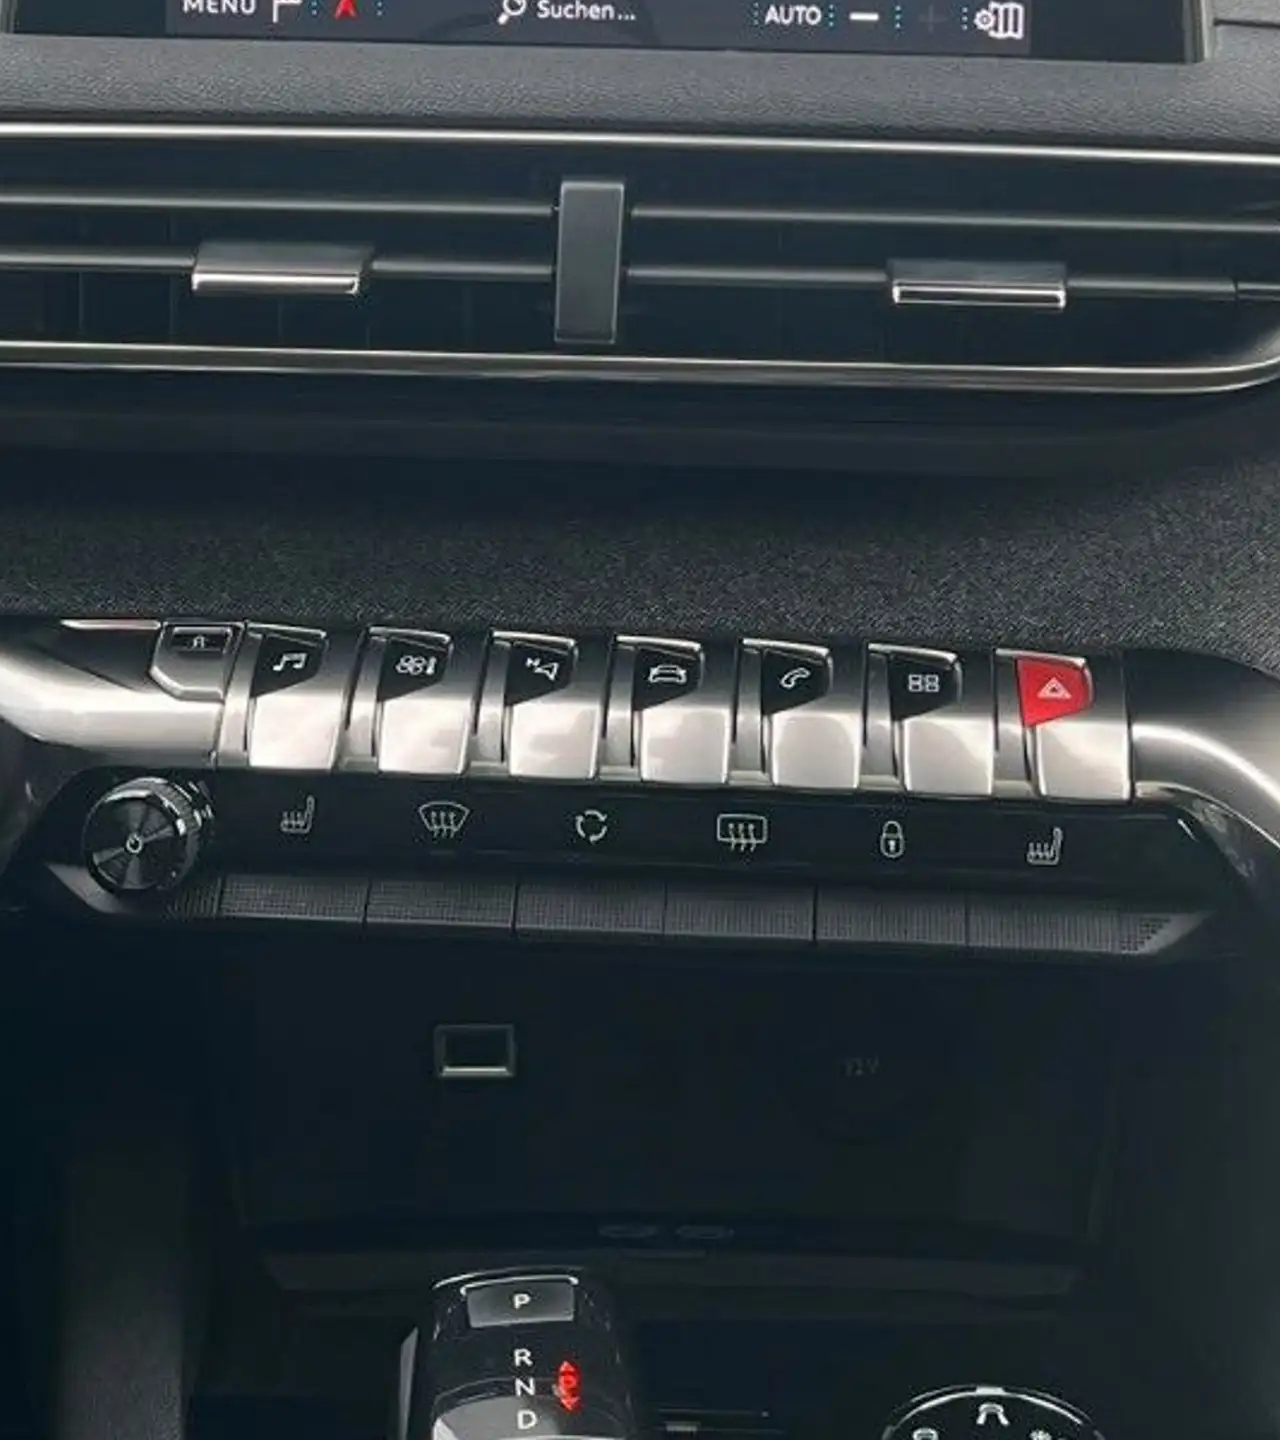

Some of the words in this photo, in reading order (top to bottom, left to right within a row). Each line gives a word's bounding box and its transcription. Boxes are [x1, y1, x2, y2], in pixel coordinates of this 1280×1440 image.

[765, 5, 821, 25] AUTO
[514, 1293, 531, 1309] P
[514, 1348, 533, 1367] R
[514, 1377, 536, 1396] N
[517, 1410, 538, 1430] D
